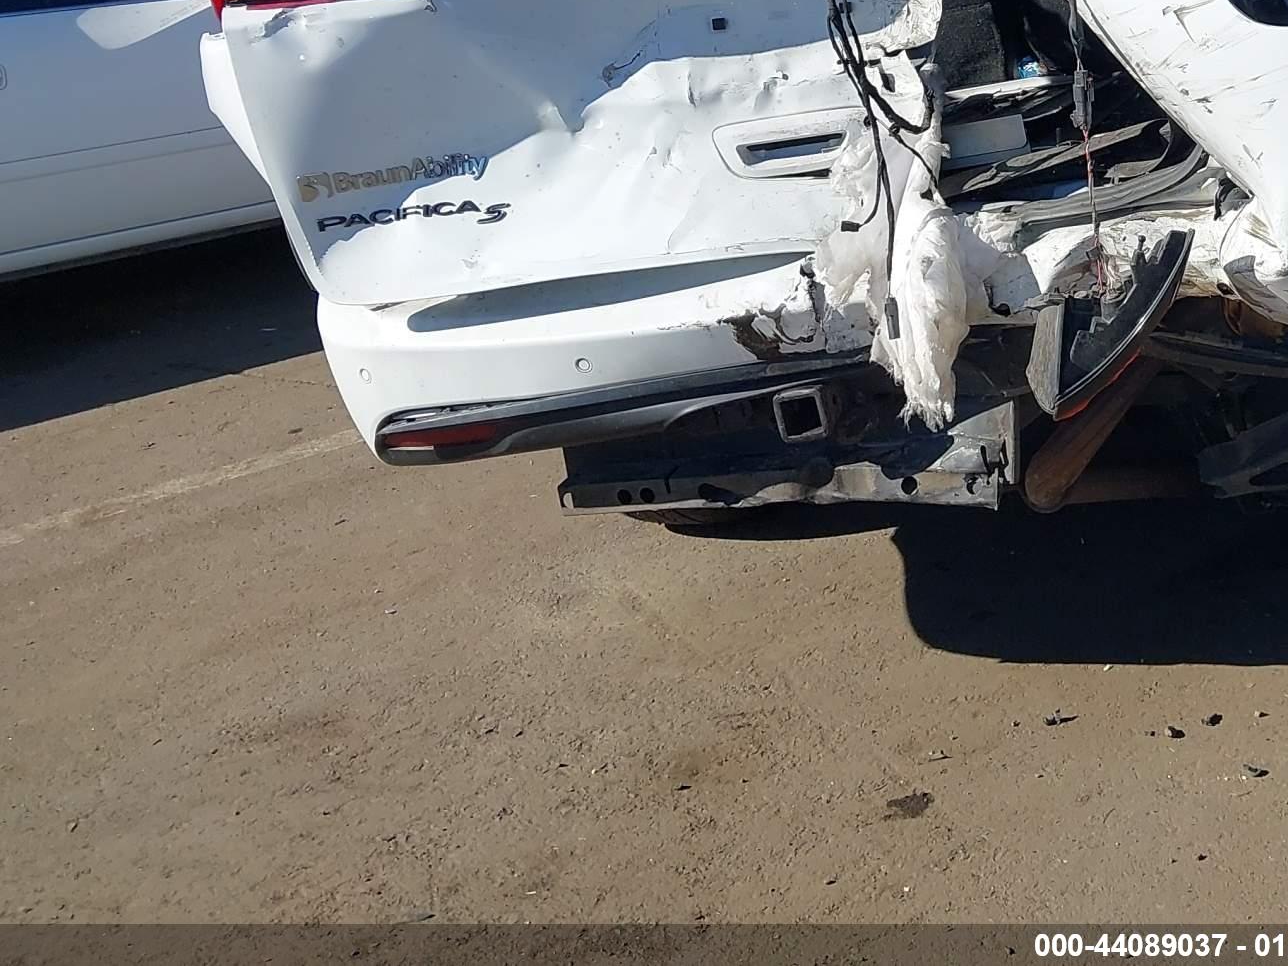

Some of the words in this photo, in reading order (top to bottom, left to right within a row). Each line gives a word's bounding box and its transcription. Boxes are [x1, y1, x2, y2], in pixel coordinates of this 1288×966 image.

[333, 153, 487, 194] BraunAbility
[316, 200, 482, 233] PACIFICA
[476, 202, 512, 225] S
